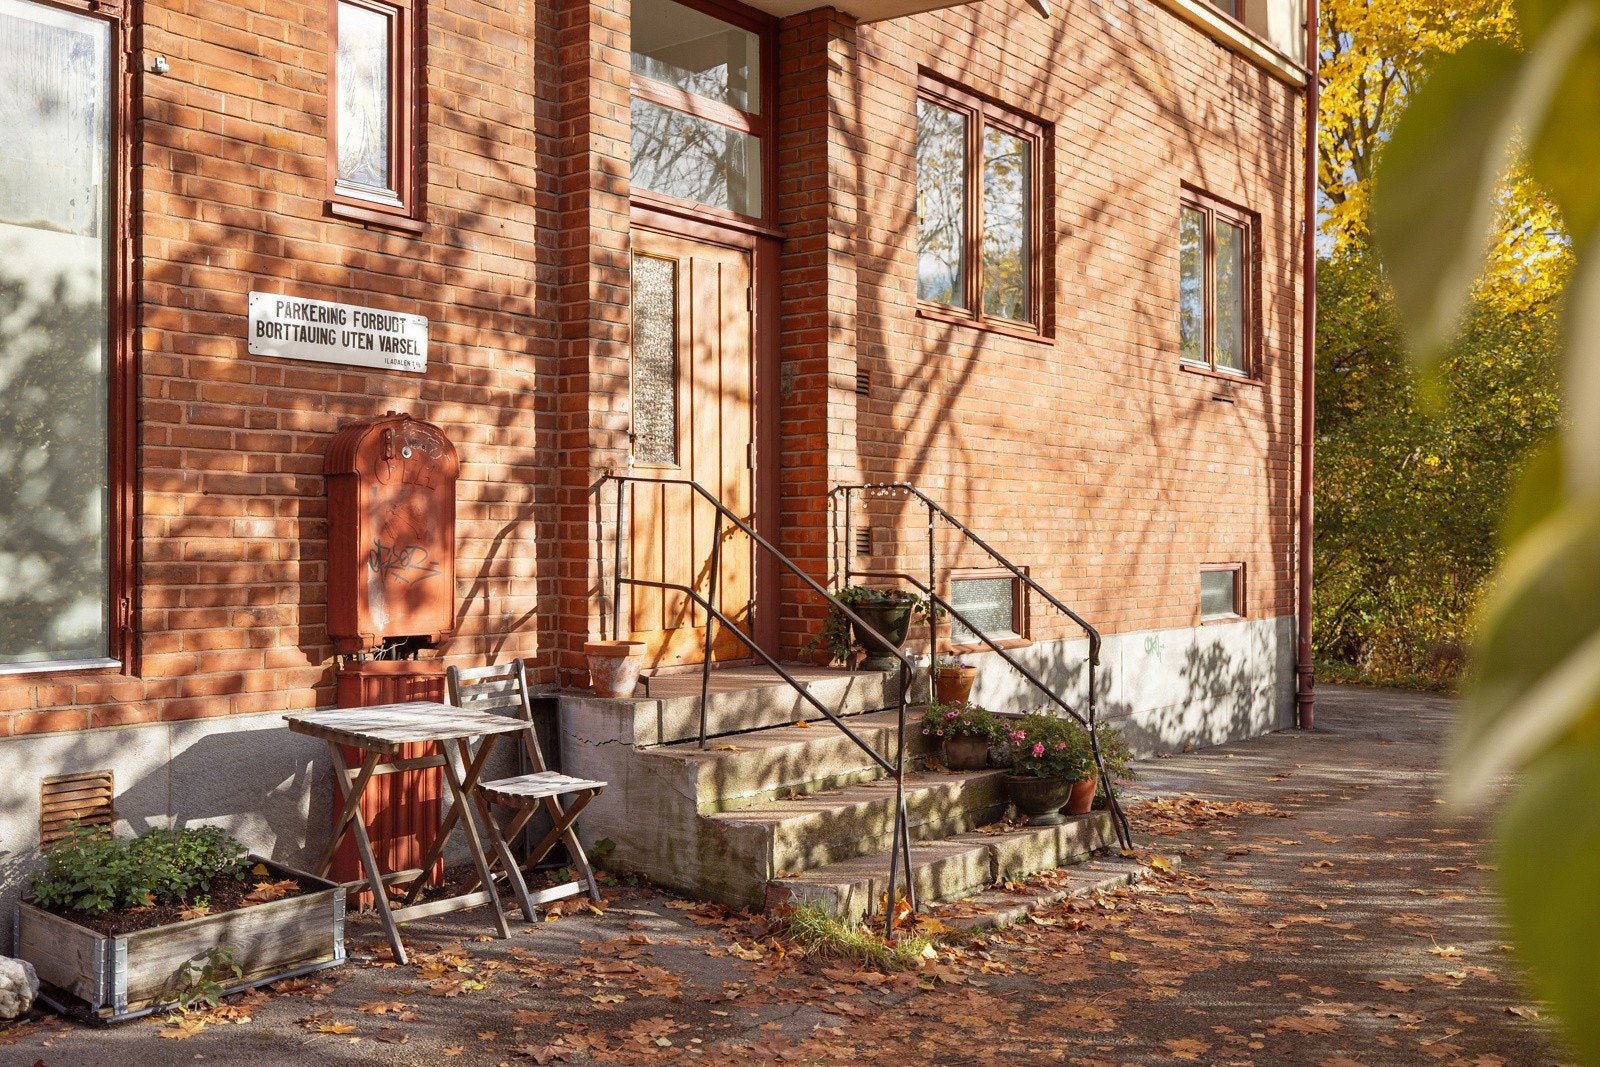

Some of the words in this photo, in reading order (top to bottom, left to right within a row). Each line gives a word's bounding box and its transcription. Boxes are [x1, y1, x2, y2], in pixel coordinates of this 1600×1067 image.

[276, 301, 347, 326] PARKERING
[353, 311, 407, 335] FORBUDT
[256, 320, 336, 346] BORTTAUING
[342, 331, 374, 351] UTEN
[379, 335, 421, 356] VARSEL
[384, 358, 411, 367] ILADALEN
